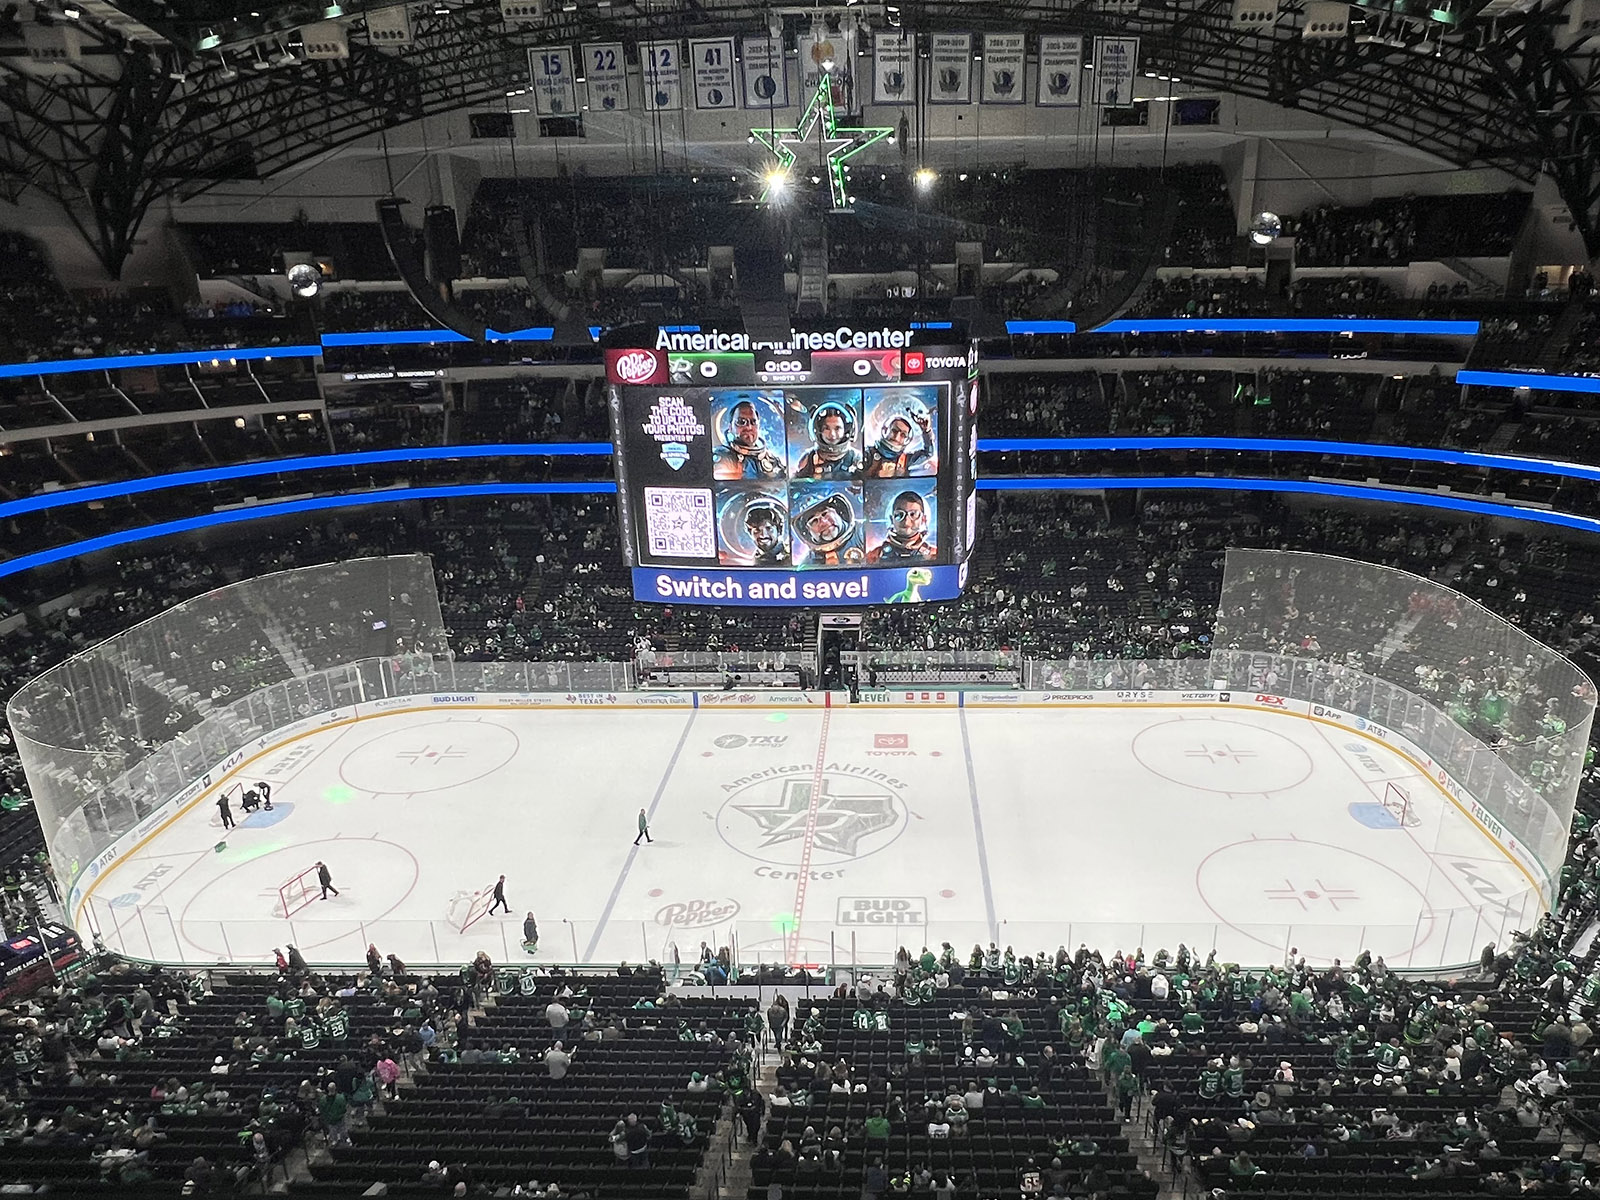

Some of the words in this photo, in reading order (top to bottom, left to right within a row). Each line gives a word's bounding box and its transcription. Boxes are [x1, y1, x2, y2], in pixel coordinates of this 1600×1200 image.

[1106, 44, 1126, 54] NBA
[594, 49, 616, 70] 22
[651, 48, 671, 67] 12
[704, 48, 722, 66] 41
[541, 54, 562, 75] 15
[765, 360, 802, 372] 0:00
[854, 360, 870, 376] 0
[926, 356, 966, 368] TOYOTA
[700, 361, 718, 378] 0
[658, 397, 684, 406] SCAN
[650, 406, 669, 416] THE
[670, 406, 693, 416] CODE
[649, 415, 661, 424] TO
[662, 416, 696, 425] UPLOAD
[642, 424, 666, 434] YOUR
[667, 424, 705, 435] PHOTOS!
[656, 574, 743, 599] Switch
[748, 578, 796, 599] and
[802, 576, 868, 598] save!
[1255, 694, 1286, 705] DEX
[1367, 724, 1388, 738] AT&T
[750, 735, 788, 743] TXU
[1354, 754, 1386, 774] AT&T
[720, 762, 813, 792] American
[825, 762, 909, 790] Airlines
[1446, 778, 1465, 801] PNC
[100, 847, 117, 867] AT&T
[134, 864, 174, 891] AT&T
[754, 866, 845, 881] Center
[688, 898, 716, 912] Dr
[854, 900, 910, 911] BUD
[662, 904, 734, 925] Pepper
[842, 911, 922, 923] LIGHT
[6, 966, 22, 976] RIDE
[23, 958, 37, 968] LIKE
[43, 947, 61, 959] SAR
[858, 1017, 868, 1029] 14
[303, 1032, 314, 1042] 21
[332, 1024, 345, 1037] 29
[14, 1055, 28, 1064] 53
